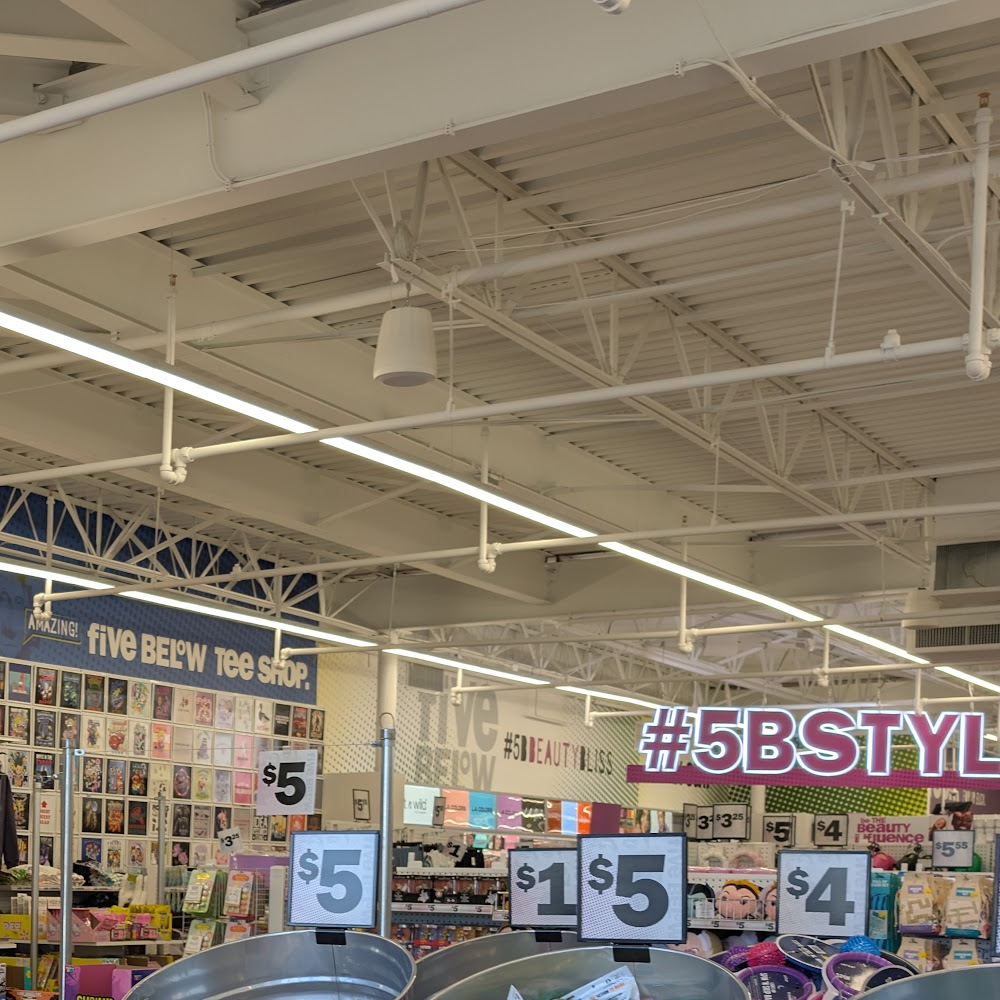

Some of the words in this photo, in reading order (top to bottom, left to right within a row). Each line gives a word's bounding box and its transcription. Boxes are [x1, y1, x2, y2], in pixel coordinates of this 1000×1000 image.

[87, 622, 137, 662] five
[140, 633, 207, 673] BELOW
[262, 762, 306, 806] $5
[765, 821, 792, 843] $5
[817, 819, 843, 841] $4
[297, 849, 363, 914] $5
[516, 862, 577, 915] $1
[587, 854, 670, 928] $5
[786, 867, 855, 926] $4
